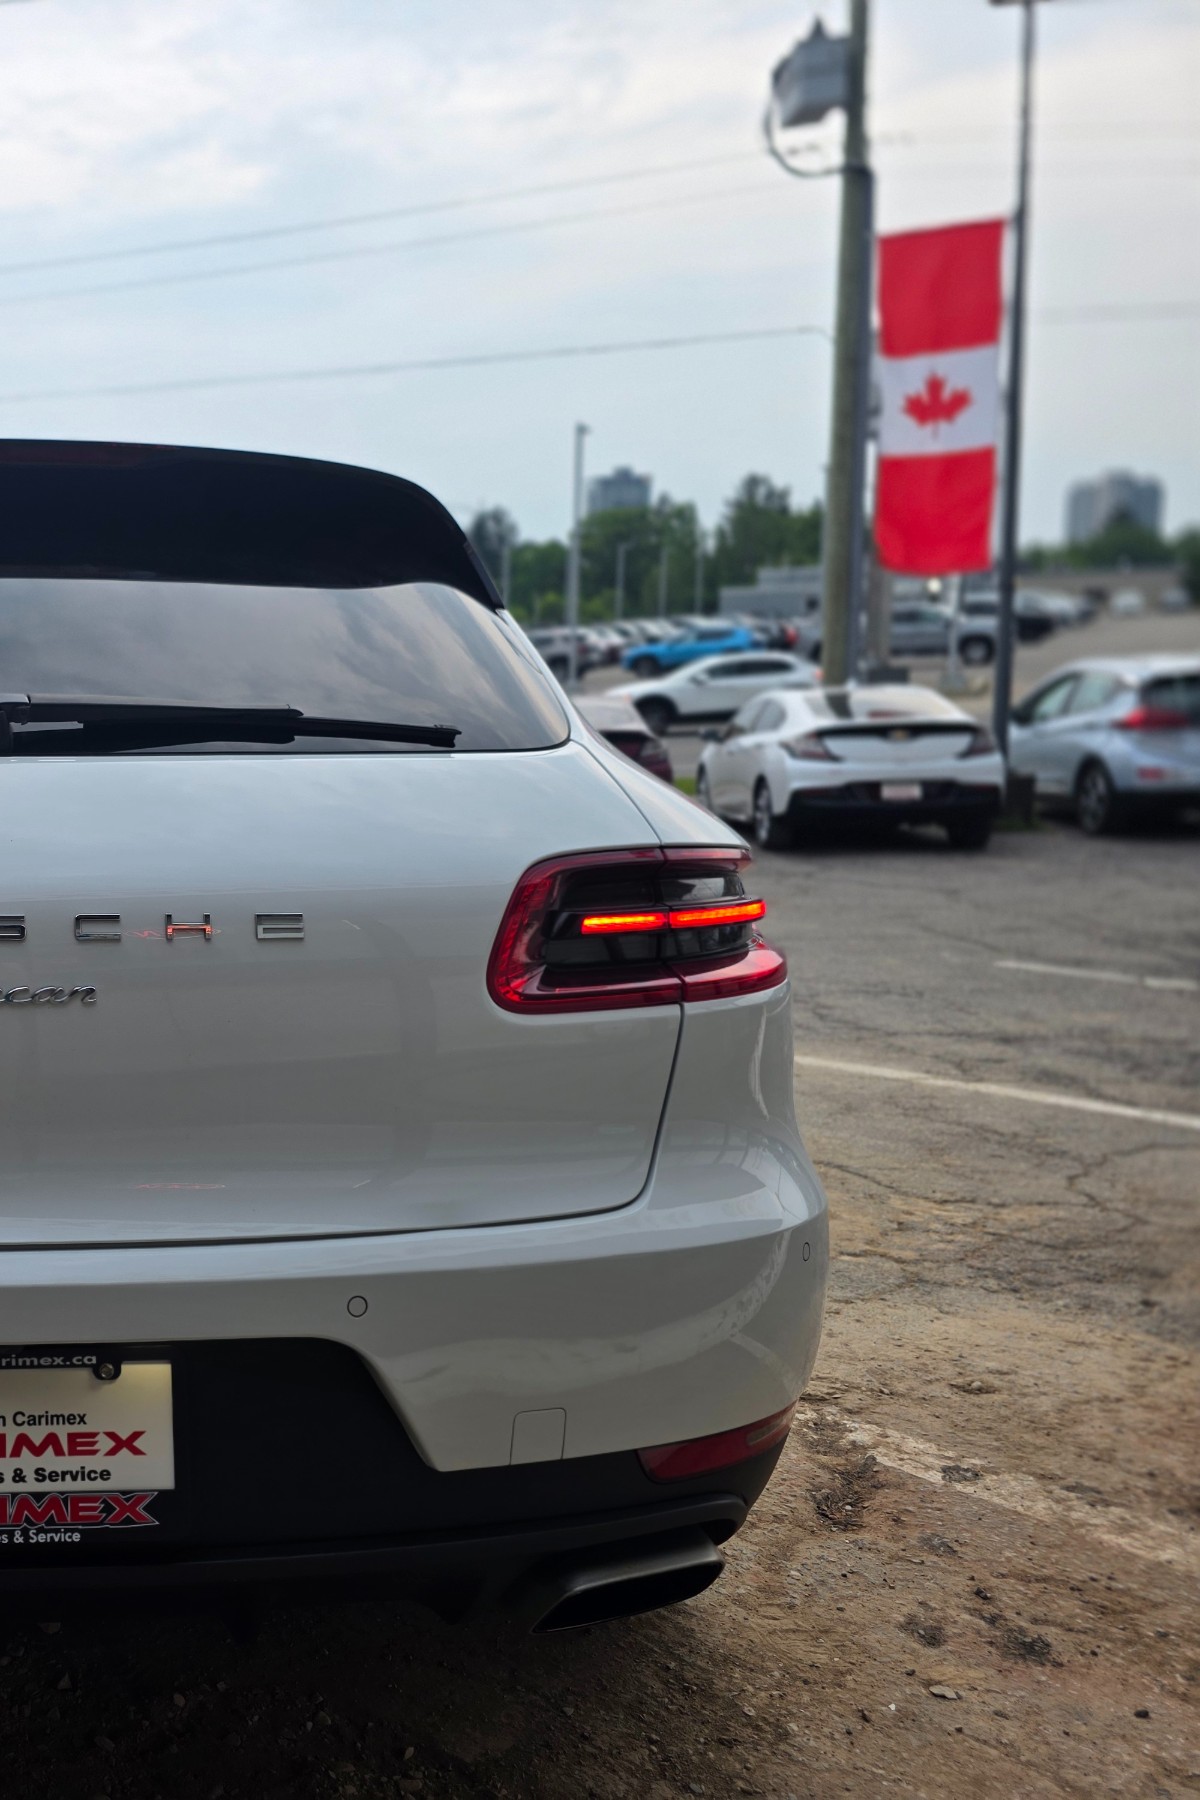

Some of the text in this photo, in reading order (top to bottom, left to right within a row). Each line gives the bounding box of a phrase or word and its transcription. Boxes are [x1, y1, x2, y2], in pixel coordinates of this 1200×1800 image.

[12, 1410, 87, 1427] Carimex
[11, 1467, 28, 1484] &
[34, 1465, 112, 1482] Service
[13, 1529, 25, 1544] &
[28, 1528, 81, 1543] Service
